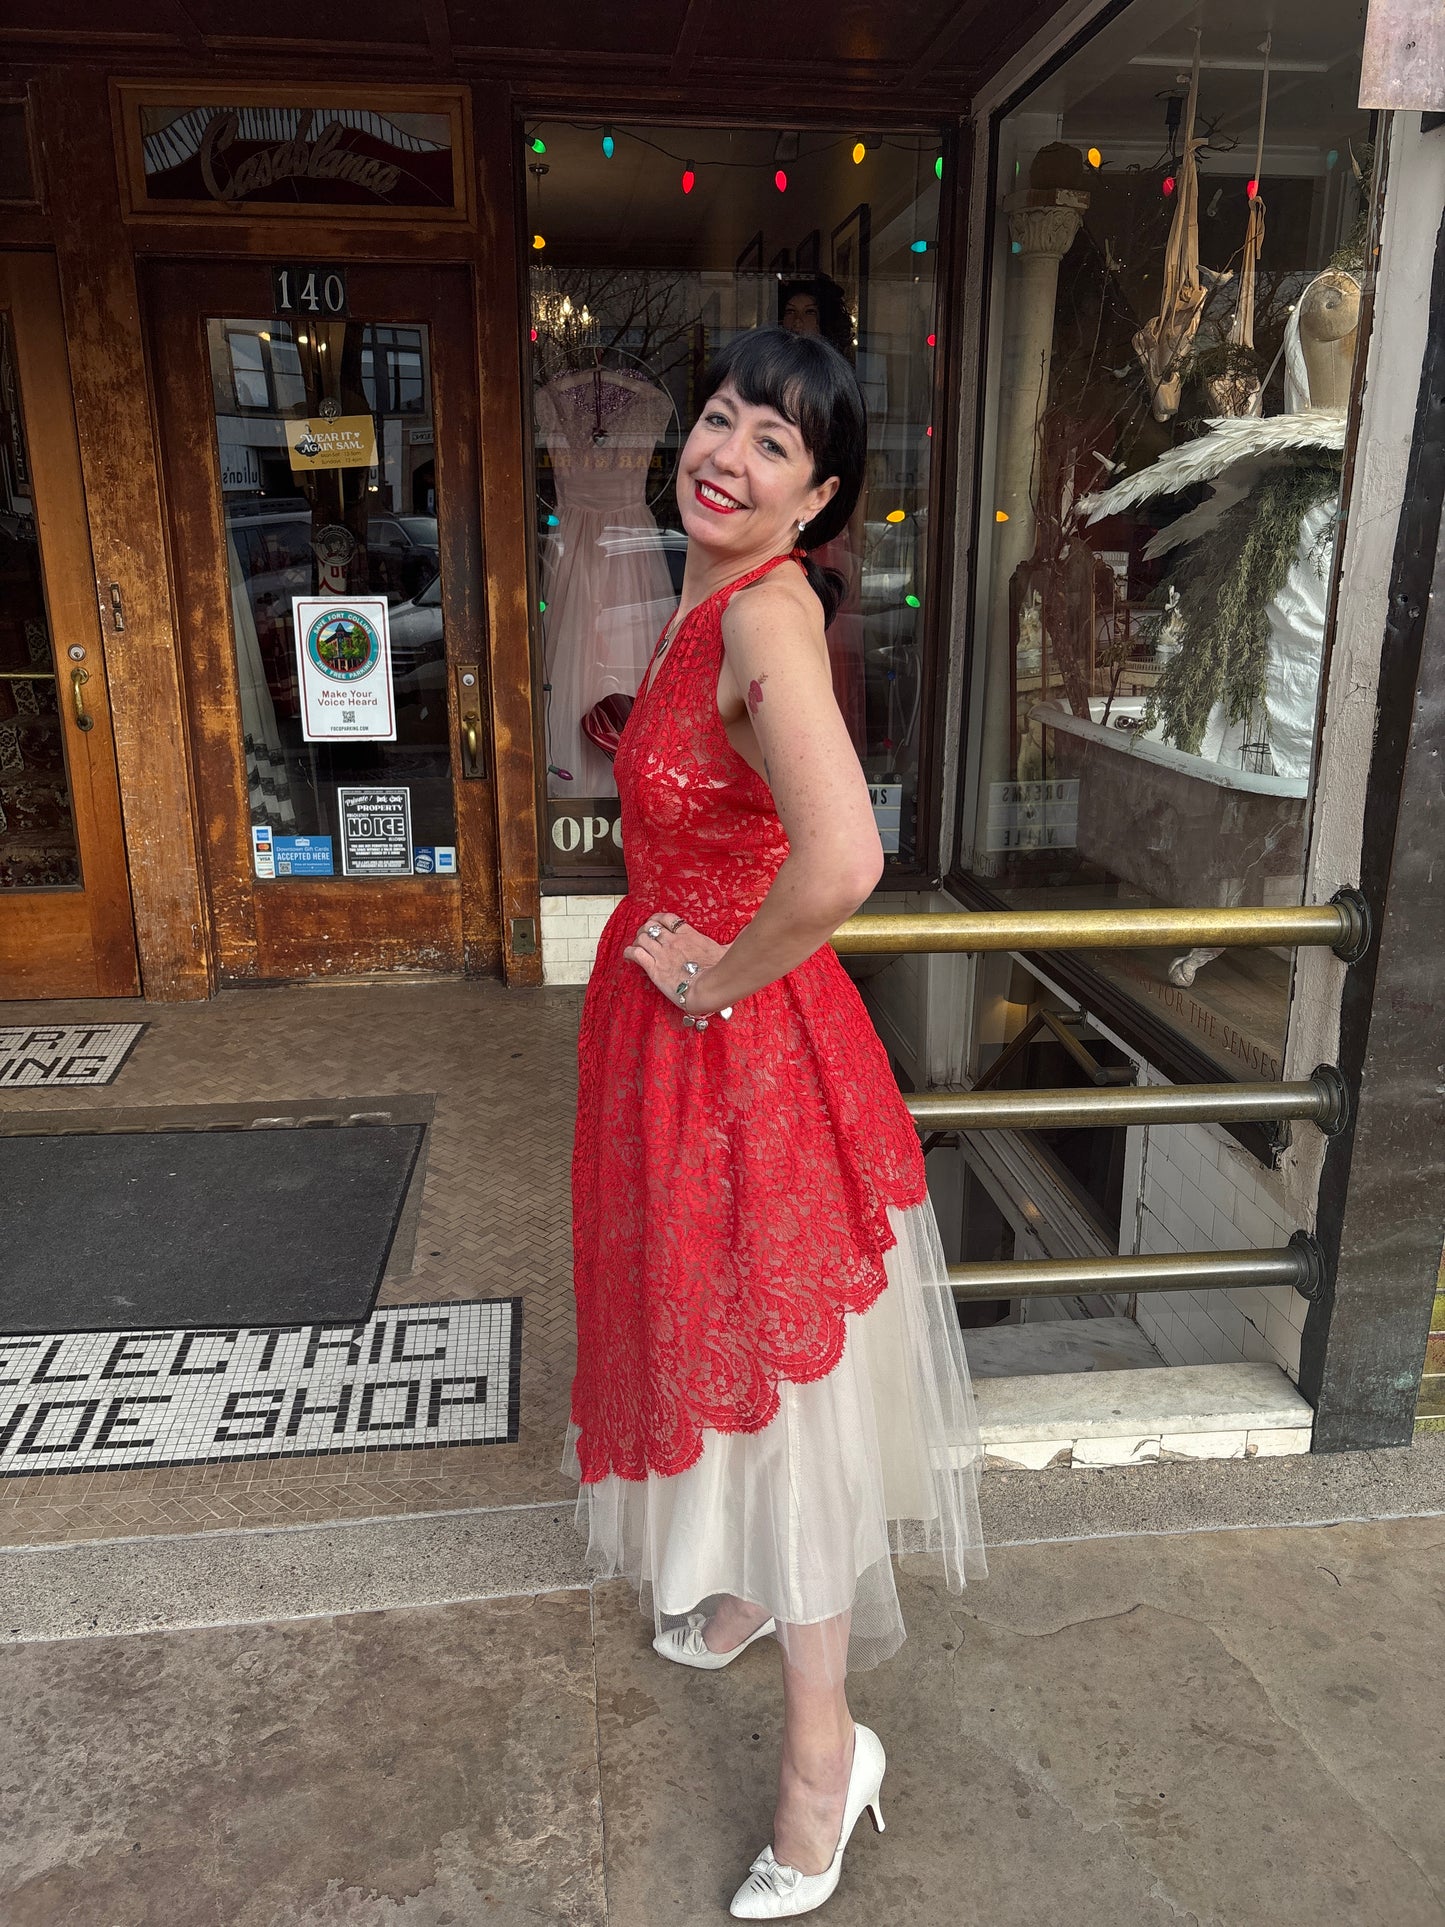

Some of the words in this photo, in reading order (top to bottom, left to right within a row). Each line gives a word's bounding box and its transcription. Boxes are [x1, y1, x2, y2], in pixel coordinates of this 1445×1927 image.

[278, 271, 344, 312] 140
[301, 433, 339, 443] WEAR
[341, 432, 352, 441] IT
[302, 443, 333, 453] AGAIN
[328, 612, 344, 621] FORT
[347, 614, 371, 634] COLLINS
[330, 670, 347, 679] FREE
[349, 660, 373, 679] PARKING
[322, 690, 347, 698] Make
[350, 690, 372, 698] Your
[348, 698, 378, 706] Heard
[347, 817, 372, 837] NO
[373, 817, 405, 836] ICE
[277, 852, 311, 861] ACCEPTED
[312, 852, 330, 860] HERE
[1189, 1000, 1217, 1040] THE
[1222, 1025, 1278, 1083] SENSES
[213, 1375, 488, 1443] SHOP
